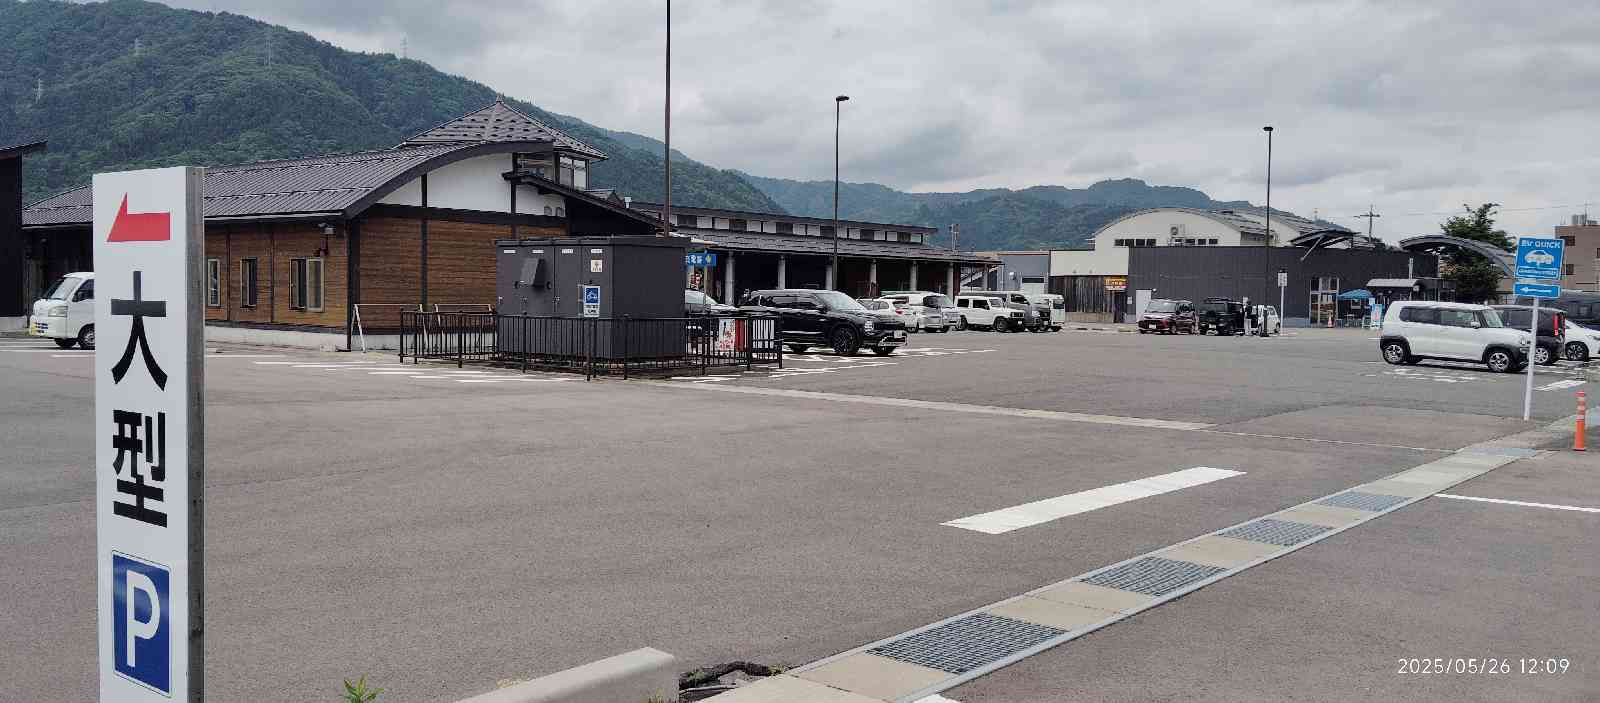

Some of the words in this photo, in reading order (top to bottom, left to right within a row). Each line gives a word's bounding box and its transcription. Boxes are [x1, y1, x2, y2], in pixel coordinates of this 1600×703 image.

[1535, 241, 1561, 249] QUICK
[110, 270, 168, 528] 大型
[126, 568, 161, 668] P
